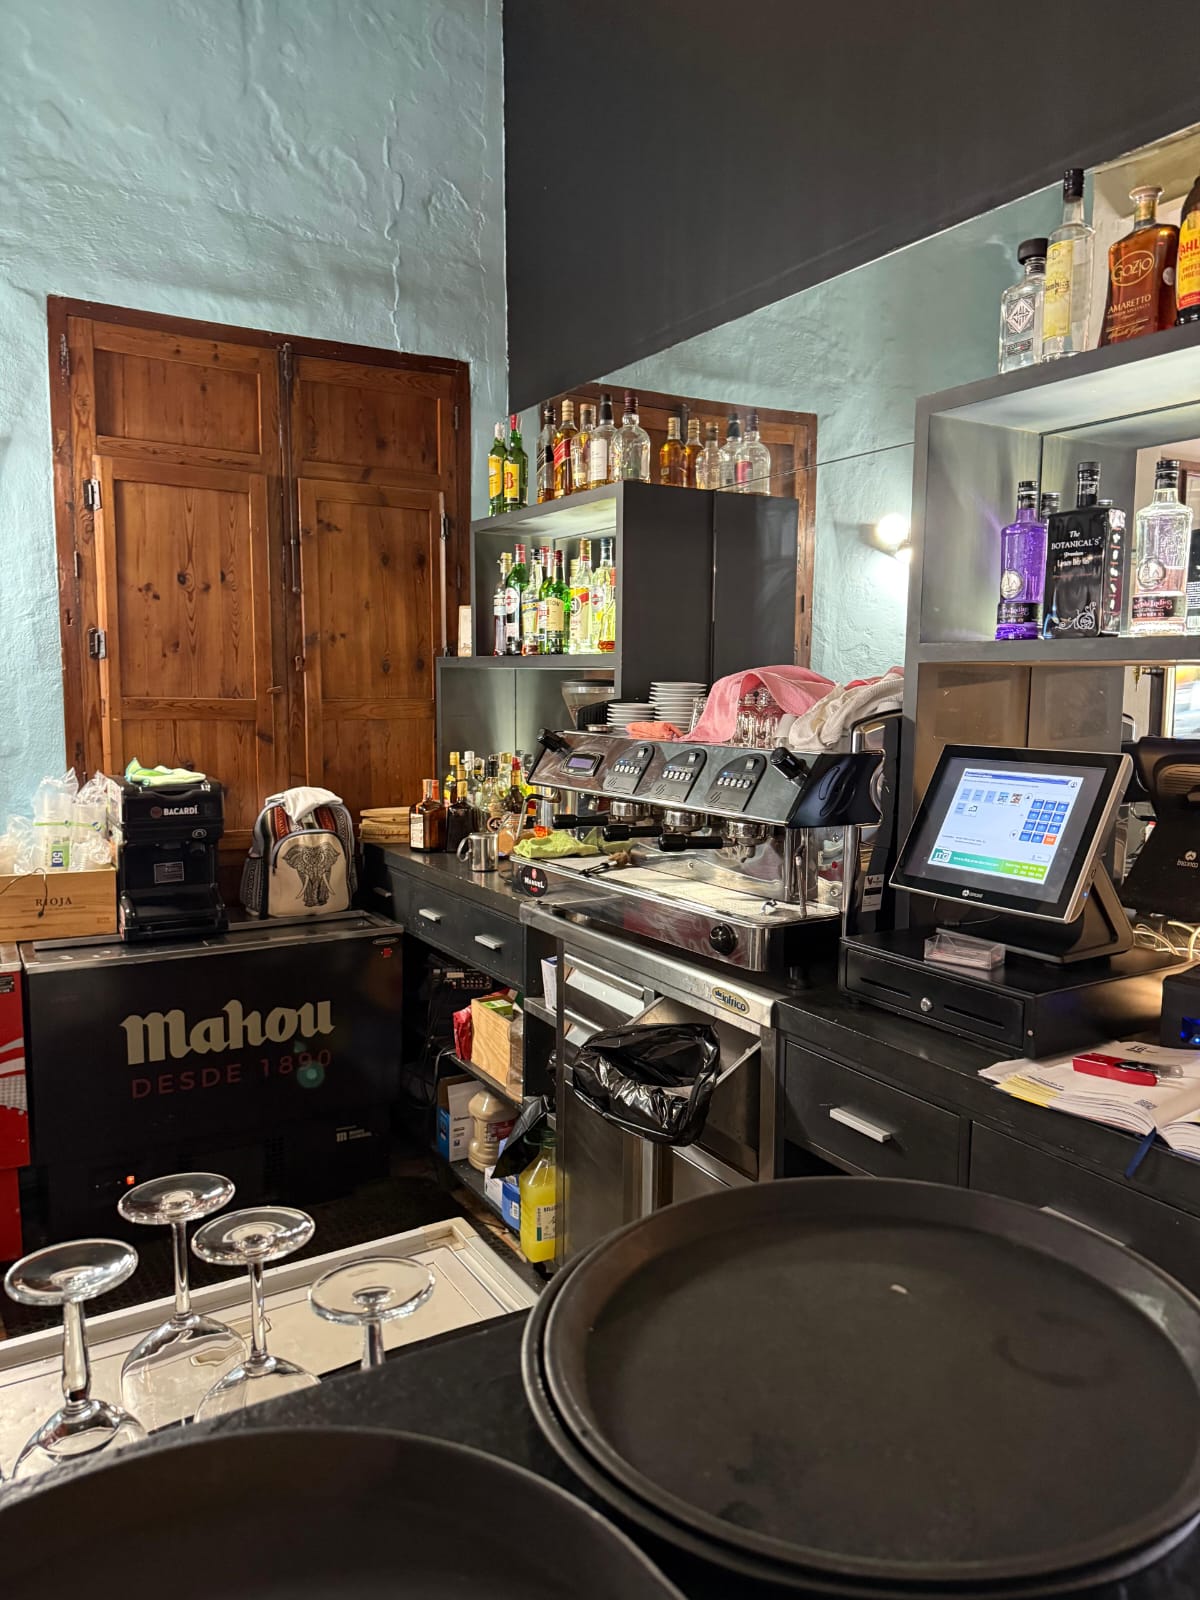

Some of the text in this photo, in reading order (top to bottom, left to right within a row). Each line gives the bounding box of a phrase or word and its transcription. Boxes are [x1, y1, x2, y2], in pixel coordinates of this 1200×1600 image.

[1108, 294, 1152, 314] AMARETTO
[1069, 530, 1081, 538] The
[163, 805, 198, 816] BACARDÍ
[51, 851, 64, 865] 50
[35, 896, 72, 907] RIOJA
[722, 991, 746, 1012] infrico
[119, 999, 336, 1066] Mahou
[131, 1049, 332, 1099] DESDE 1890
